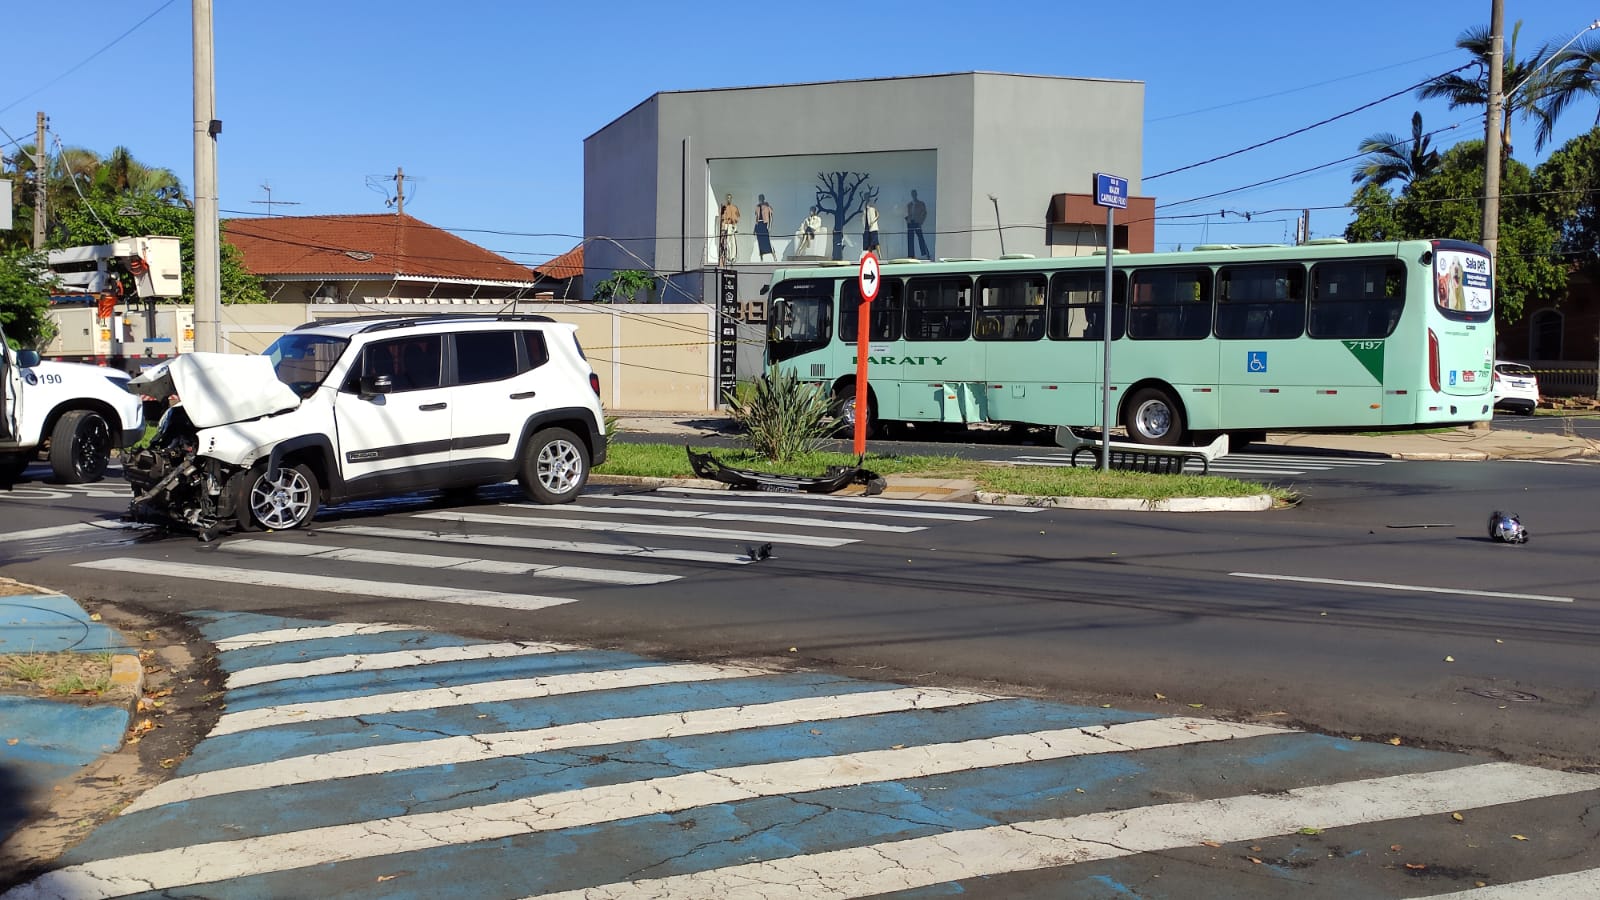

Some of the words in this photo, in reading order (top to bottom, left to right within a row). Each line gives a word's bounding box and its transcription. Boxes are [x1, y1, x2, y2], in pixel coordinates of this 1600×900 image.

[1465, 257, 1476, 270] Sala
[1477, 259, 1486, 271] pet
[1349, 341, 1383, 350] 7197
[40, 374, 62, 385] 190
